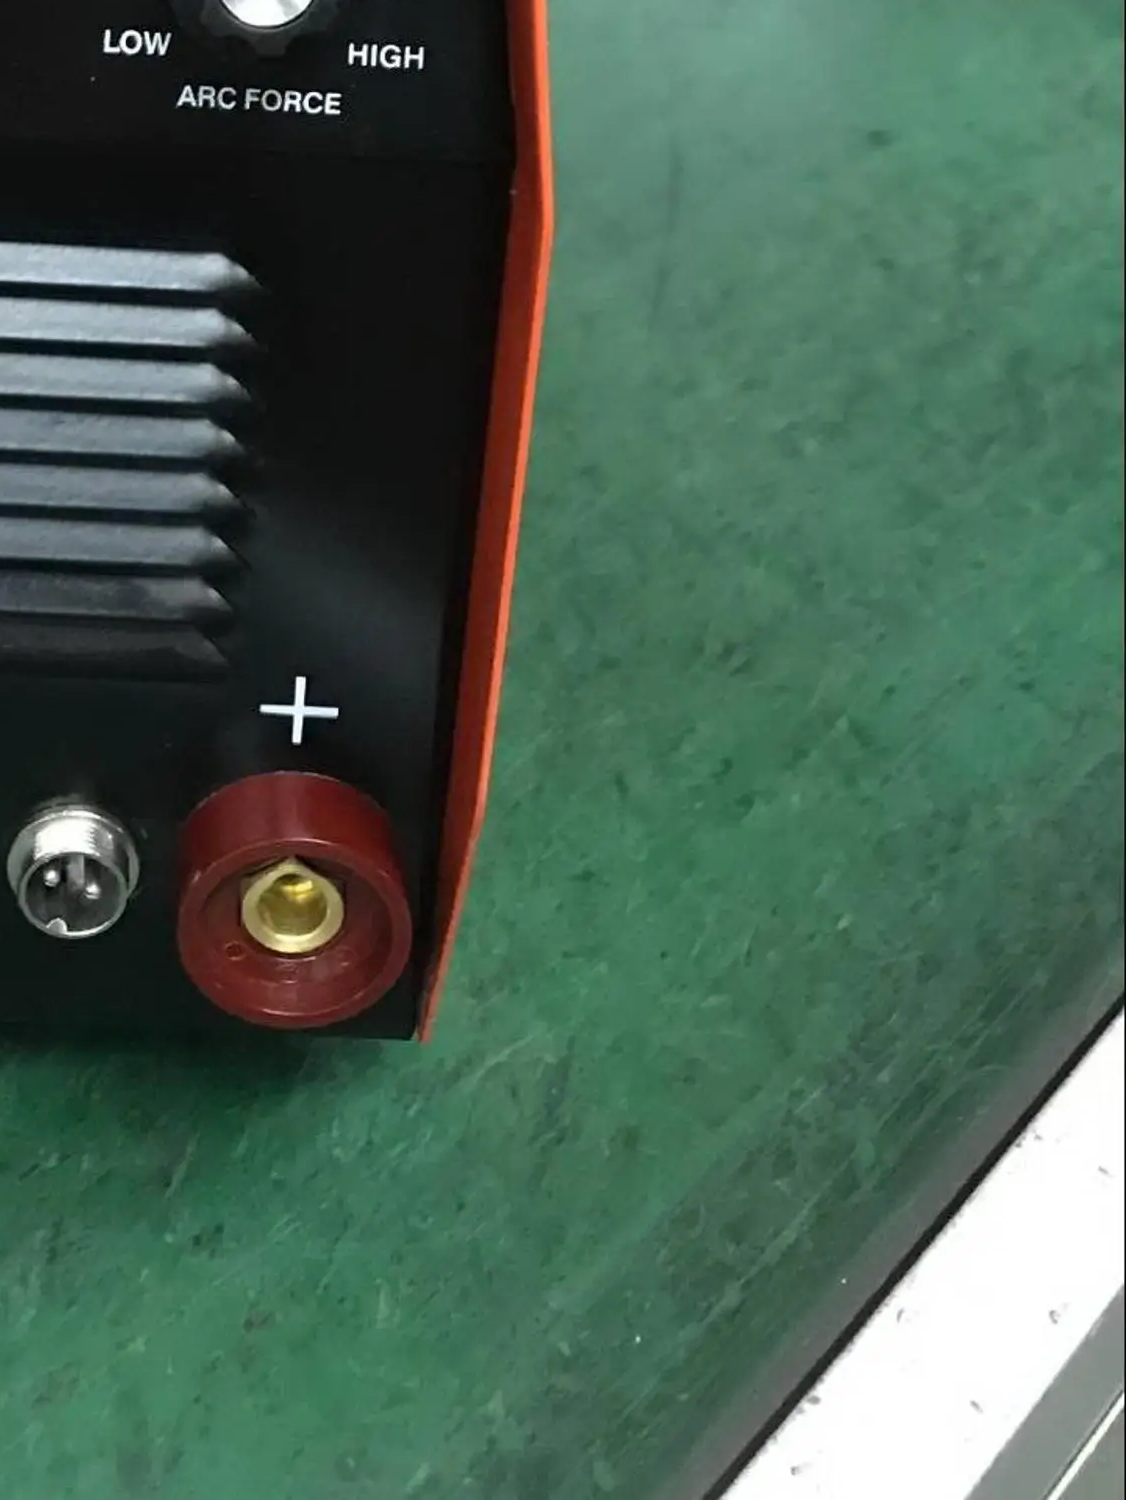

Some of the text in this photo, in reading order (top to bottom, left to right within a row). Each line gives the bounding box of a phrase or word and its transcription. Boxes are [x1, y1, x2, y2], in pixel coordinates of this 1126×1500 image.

[103, 29, 172, 56] LOW
[347, 42, 425, 70] HIGH
[176, 84, 342, 116] ARC FORCE
